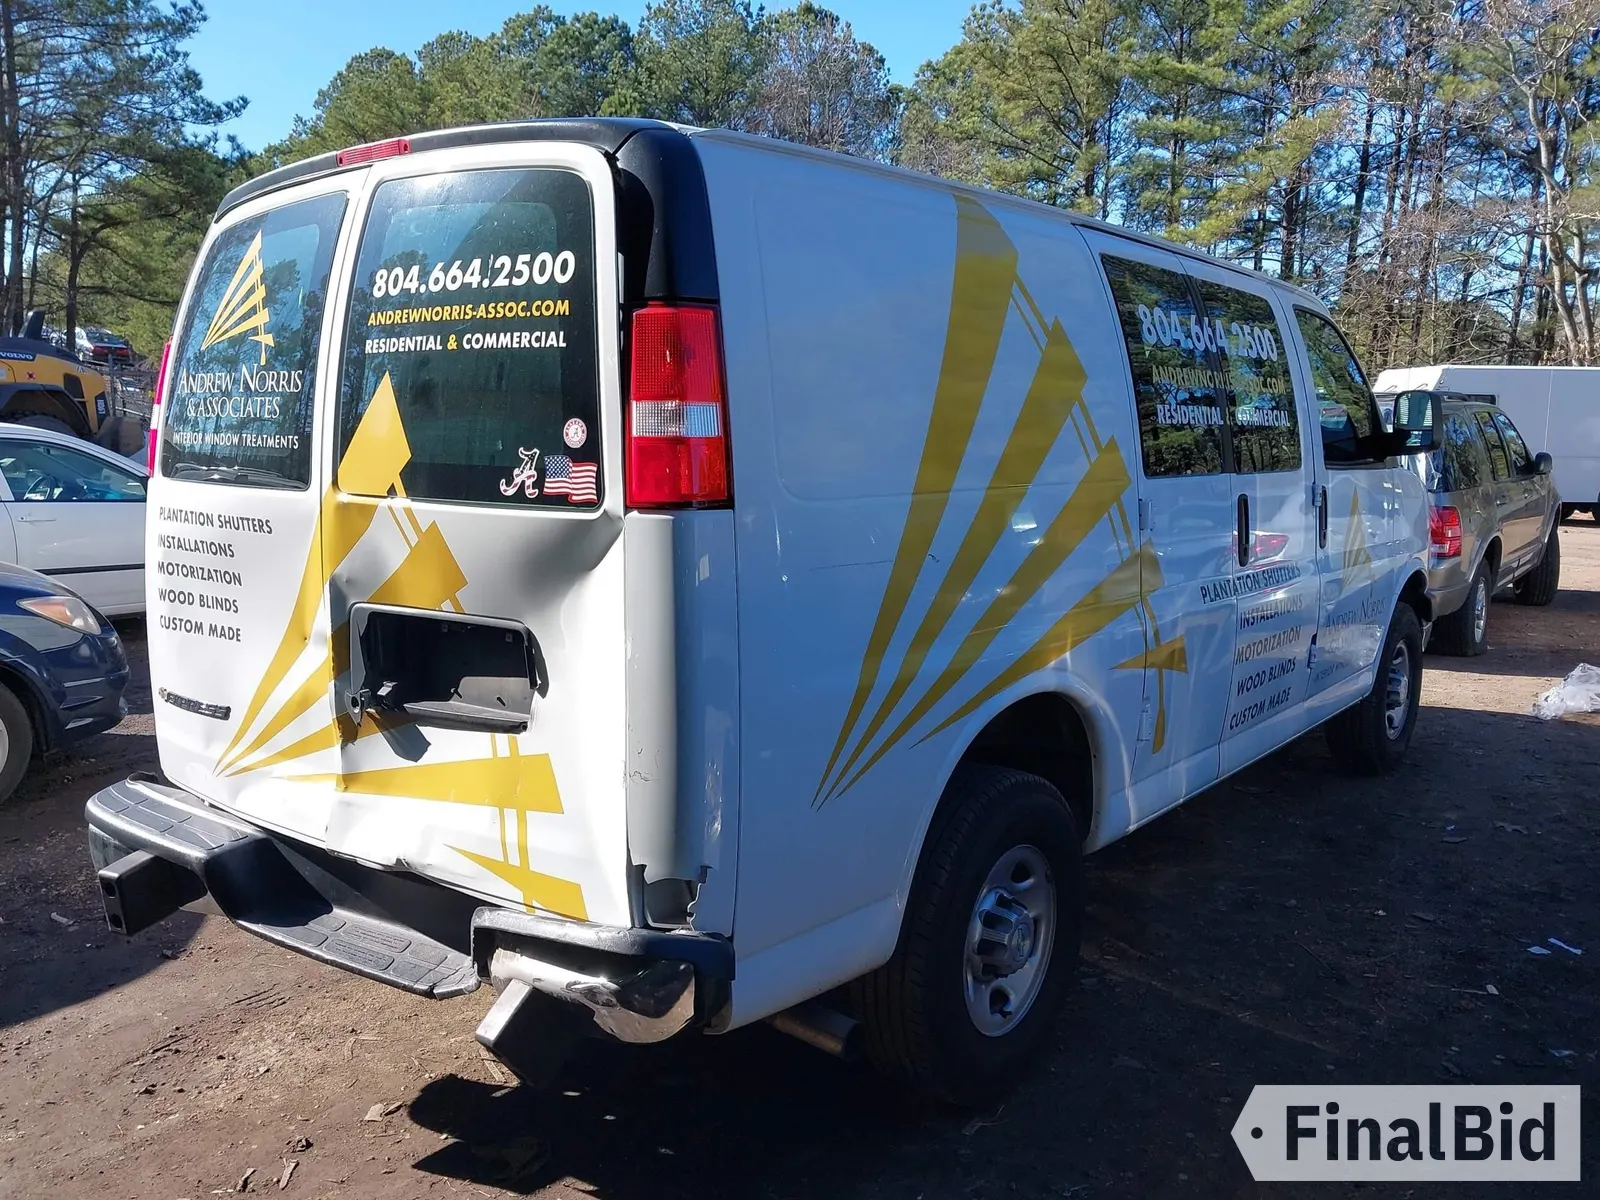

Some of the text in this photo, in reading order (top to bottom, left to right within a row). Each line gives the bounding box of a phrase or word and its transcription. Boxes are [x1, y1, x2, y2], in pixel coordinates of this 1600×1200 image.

[372, 250, 576, 298] 804.664.2500
[367, 299, 570, 326] ANDREWNORRIS-ASSOC.COM
[0, 352, 33, 360] VOLVO
[364, 331, 567, 354] RESIDENTIAL & COMMERCIAL
[177, 363, 303, 394] ANDREW NORRIS
[1157, 404, 1224, 426] RESIDENTIAL
[173, 431, 299, 450] INTERIOR WINDOW TREATMENTS
[159, 506, 273, 535] PLANTATION SHUTTERS
[158, 533, 235, 558] INSTALLATIONS
[158, 561, 242, 587] MOTORIZATION
[1200, 562, 1301, 605] PLANTATION SHUTTERS
[158, 588, 239, 614] WOOD BLINDS
[1240, 593, 1303, 630] INSTALLATIONS
[160, 615, 241, 642] CUSTOM MADE
[1235, 624, 1302, 666] MOTORIZATION
[1237, 669, 1266, 697] WOOD
[1268, 657, 1296, 680] BLINDS
[1229, 687, 1292, 731] CUSTOM MADE
